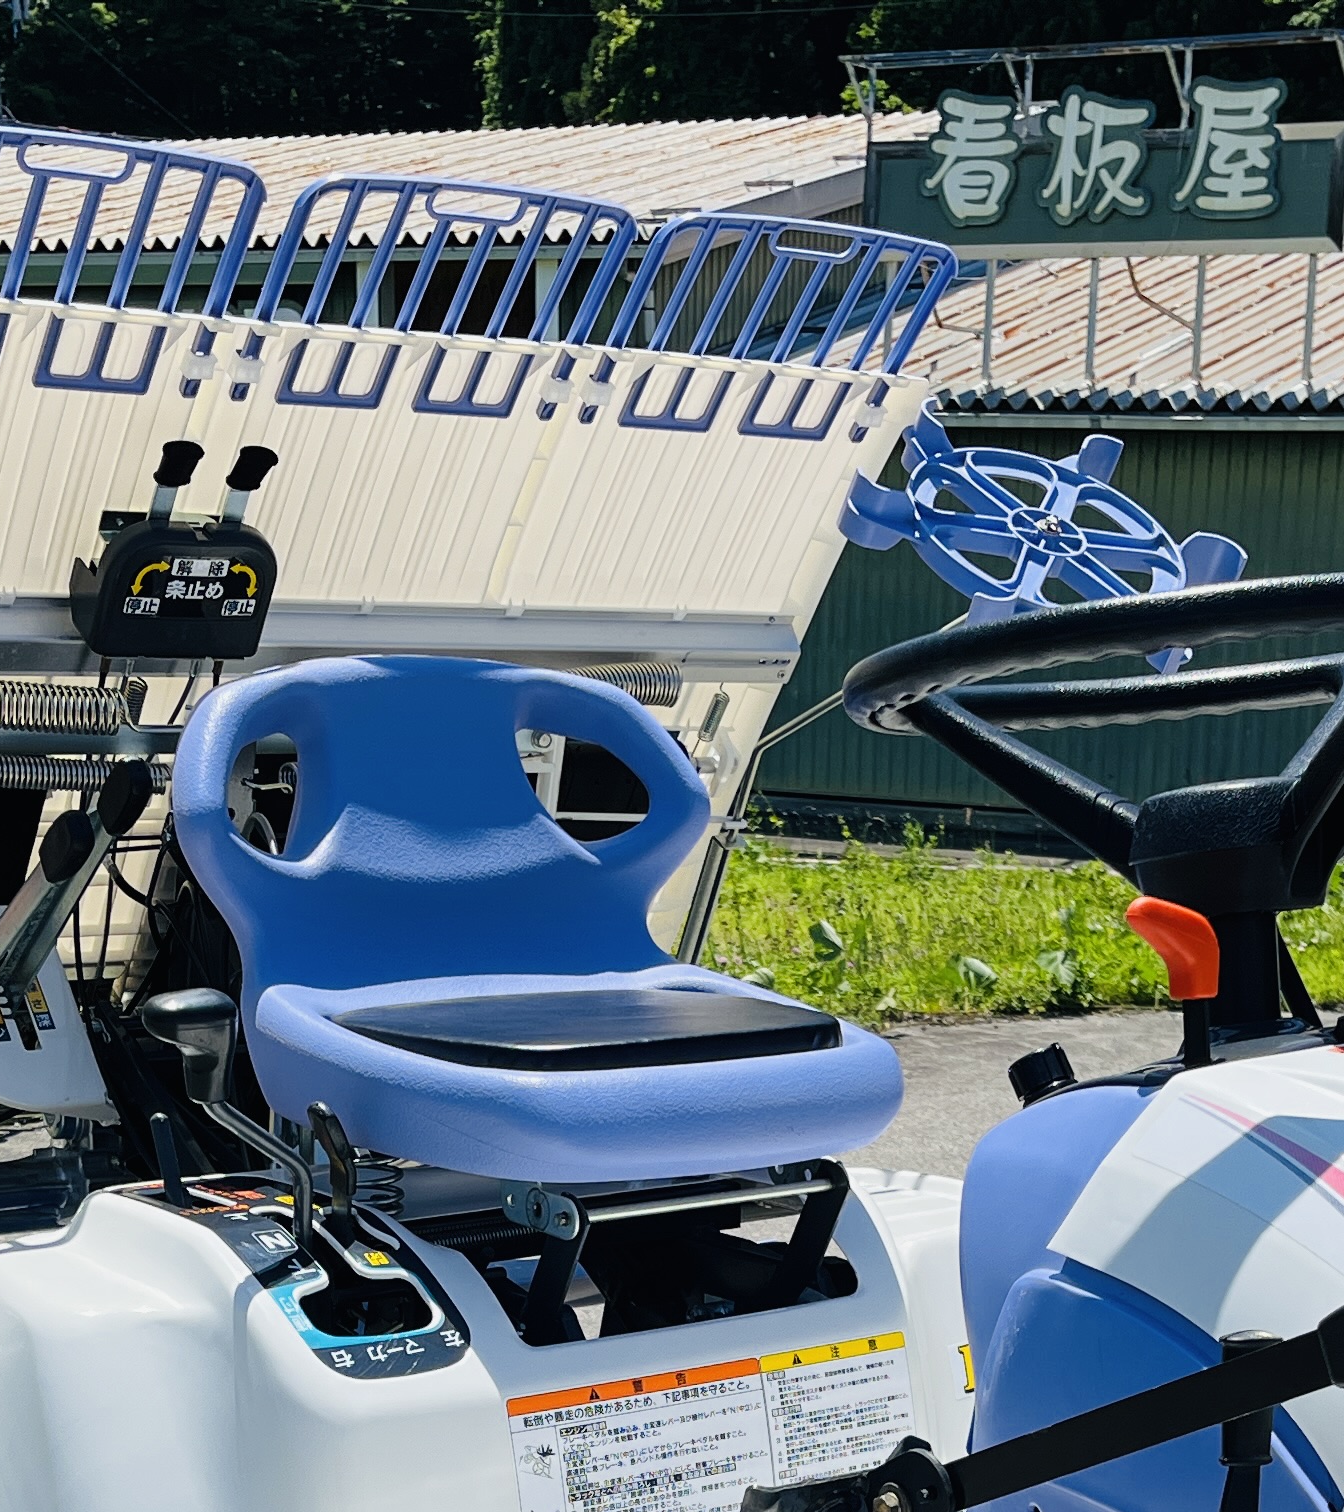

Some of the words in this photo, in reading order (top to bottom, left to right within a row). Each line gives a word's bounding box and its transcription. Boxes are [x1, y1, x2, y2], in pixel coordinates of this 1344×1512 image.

[924, 84, 1281, 220] 看板屋
[176, 559, 224, 577] 解除
[165, 580, 224, 600] 条止め
[126, 598, 158, 615] 停止
[223, 599, 254, 616] 停止
[258, 1232, 292, 1250] N
[440, 1330, 465, 1348] 左
[330, 1349, 355, 1368] 右
[367, 1338, 426, 1362] マーカ
